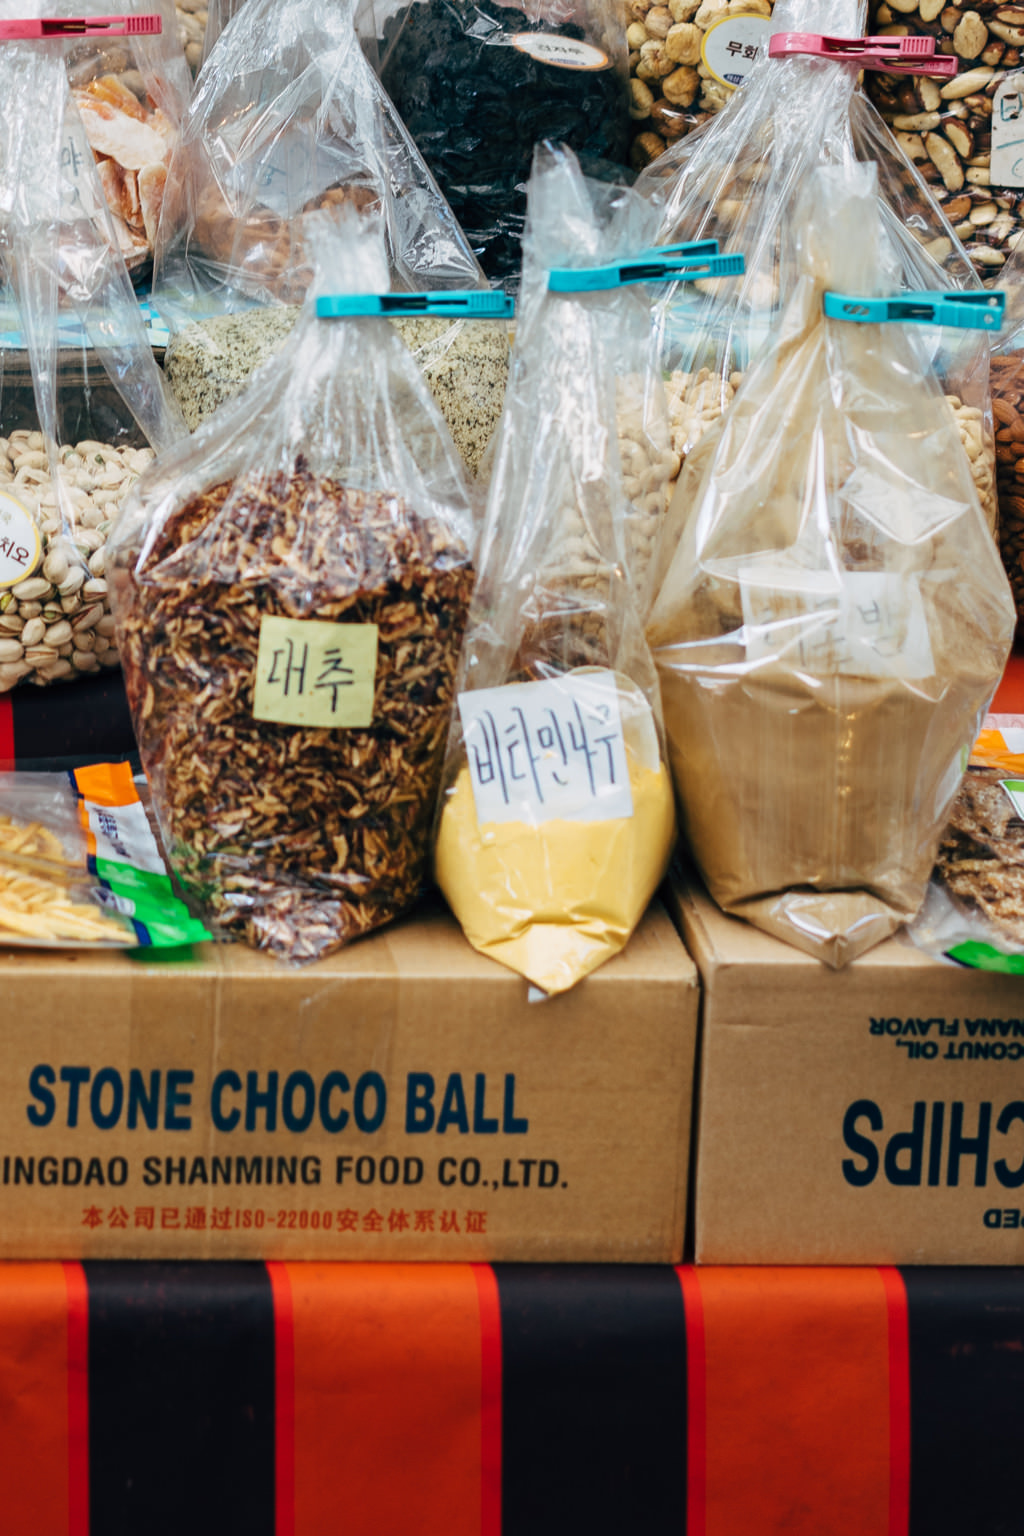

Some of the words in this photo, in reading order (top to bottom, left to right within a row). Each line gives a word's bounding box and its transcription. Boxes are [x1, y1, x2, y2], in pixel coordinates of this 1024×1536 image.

[267, 638, 354, 713] 대추
[869, 1017, 961, 1038] FLAVOR
[942, 1040, 1024, 1061] CONUT
[26, 1063, 195, 1132] STONE
[210, 1069, 387, 1134] CHOCO
[404, 1072, 529, 1135] BALL
[842, 1099, 1024, 1189] CHIPS
[142, 1155, 321, 1187] SHANMING
[336, 1155, 424, 1186] FOOD
[81, 1205, 487, 1234] 本公司已通过ISO-22000安全体系认证
